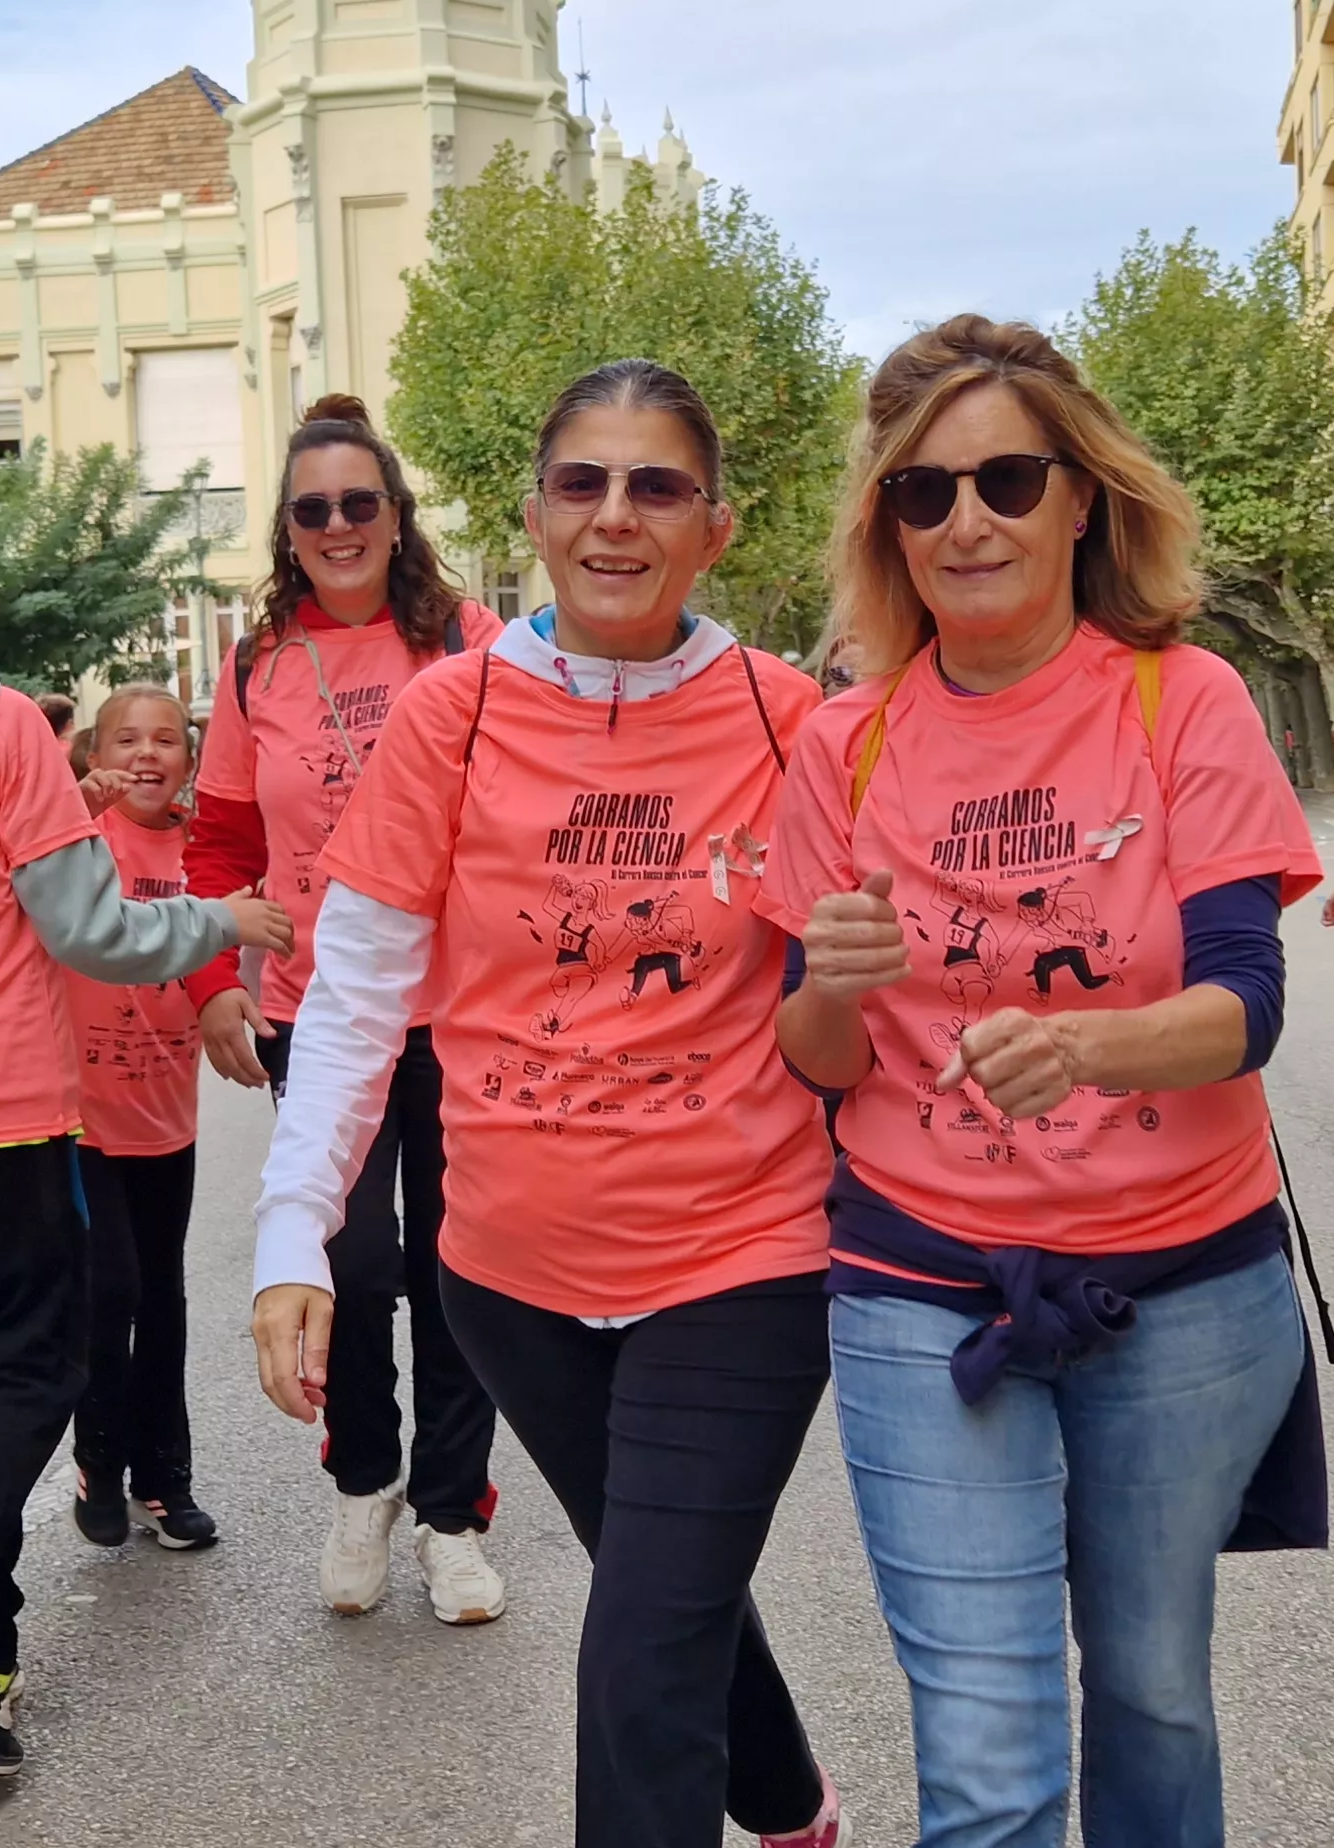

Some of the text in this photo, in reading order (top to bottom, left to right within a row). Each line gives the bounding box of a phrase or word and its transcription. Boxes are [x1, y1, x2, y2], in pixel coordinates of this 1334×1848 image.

[568, 793, 674, 830] CORRAMOS
[951, 786, 1057, 836] CORRAMOS
[545, 828, 686, 868] POR LA CIENCIA
[930, 820, 1076, 873] POR LA CIENCIA
[560, 932, 574, 949] 19
[602, 1073, 641, 1087] URBAN
